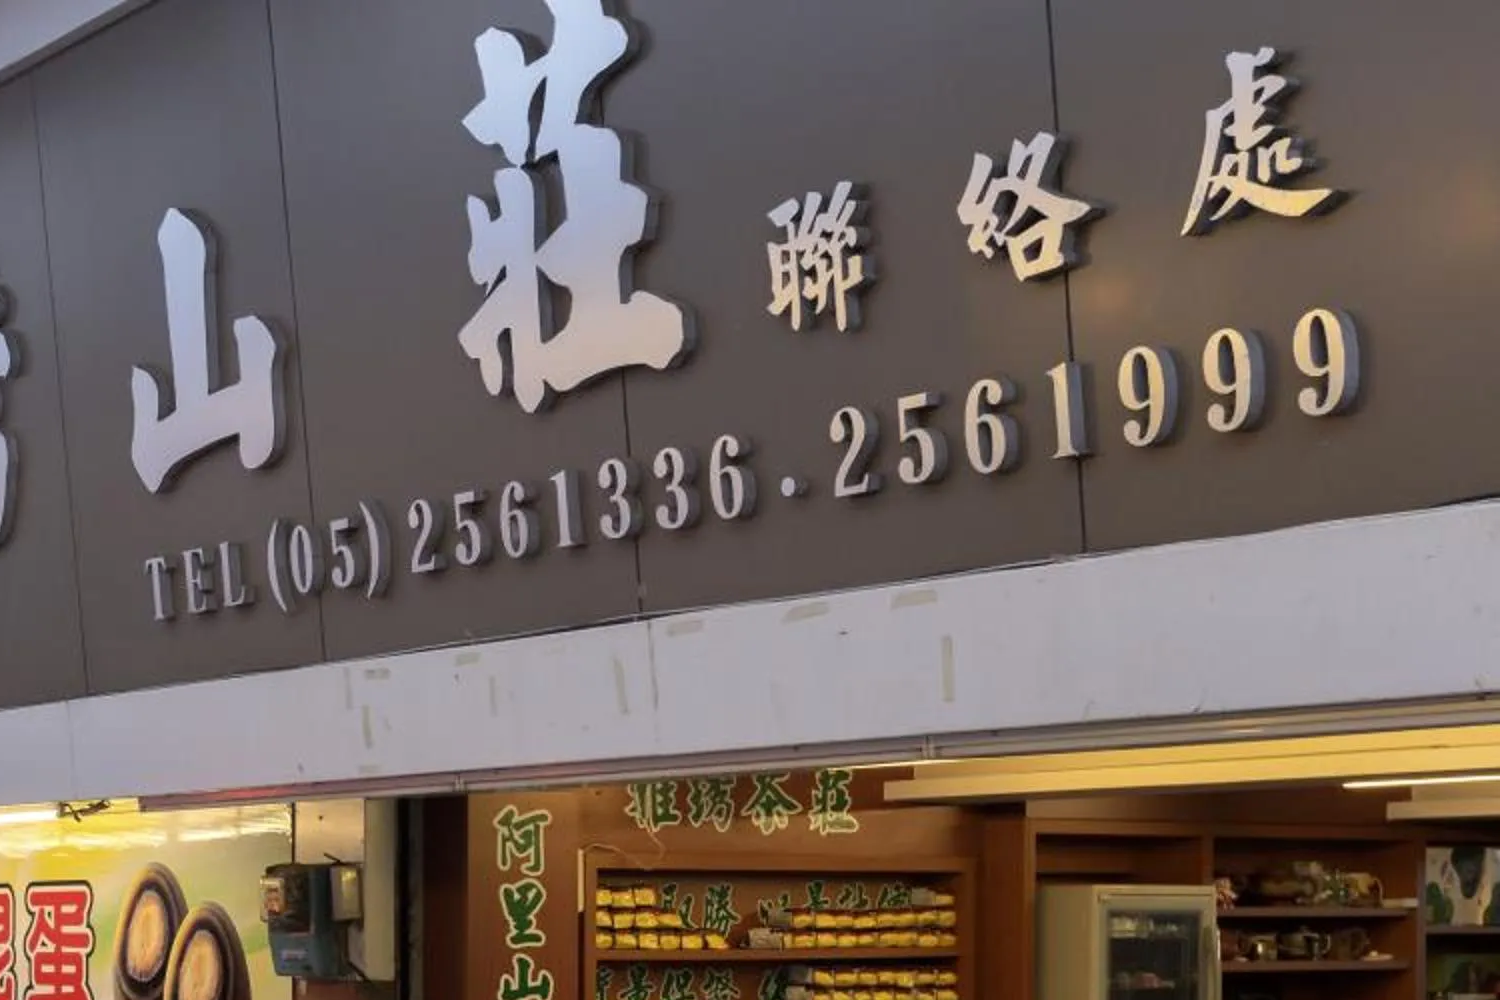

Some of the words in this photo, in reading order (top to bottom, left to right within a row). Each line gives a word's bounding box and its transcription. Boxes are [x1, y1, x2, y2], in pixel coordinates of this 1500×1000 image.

[766, 47, 1335, 331] 聯絡處
[145, 541, 248, 621] TEL
